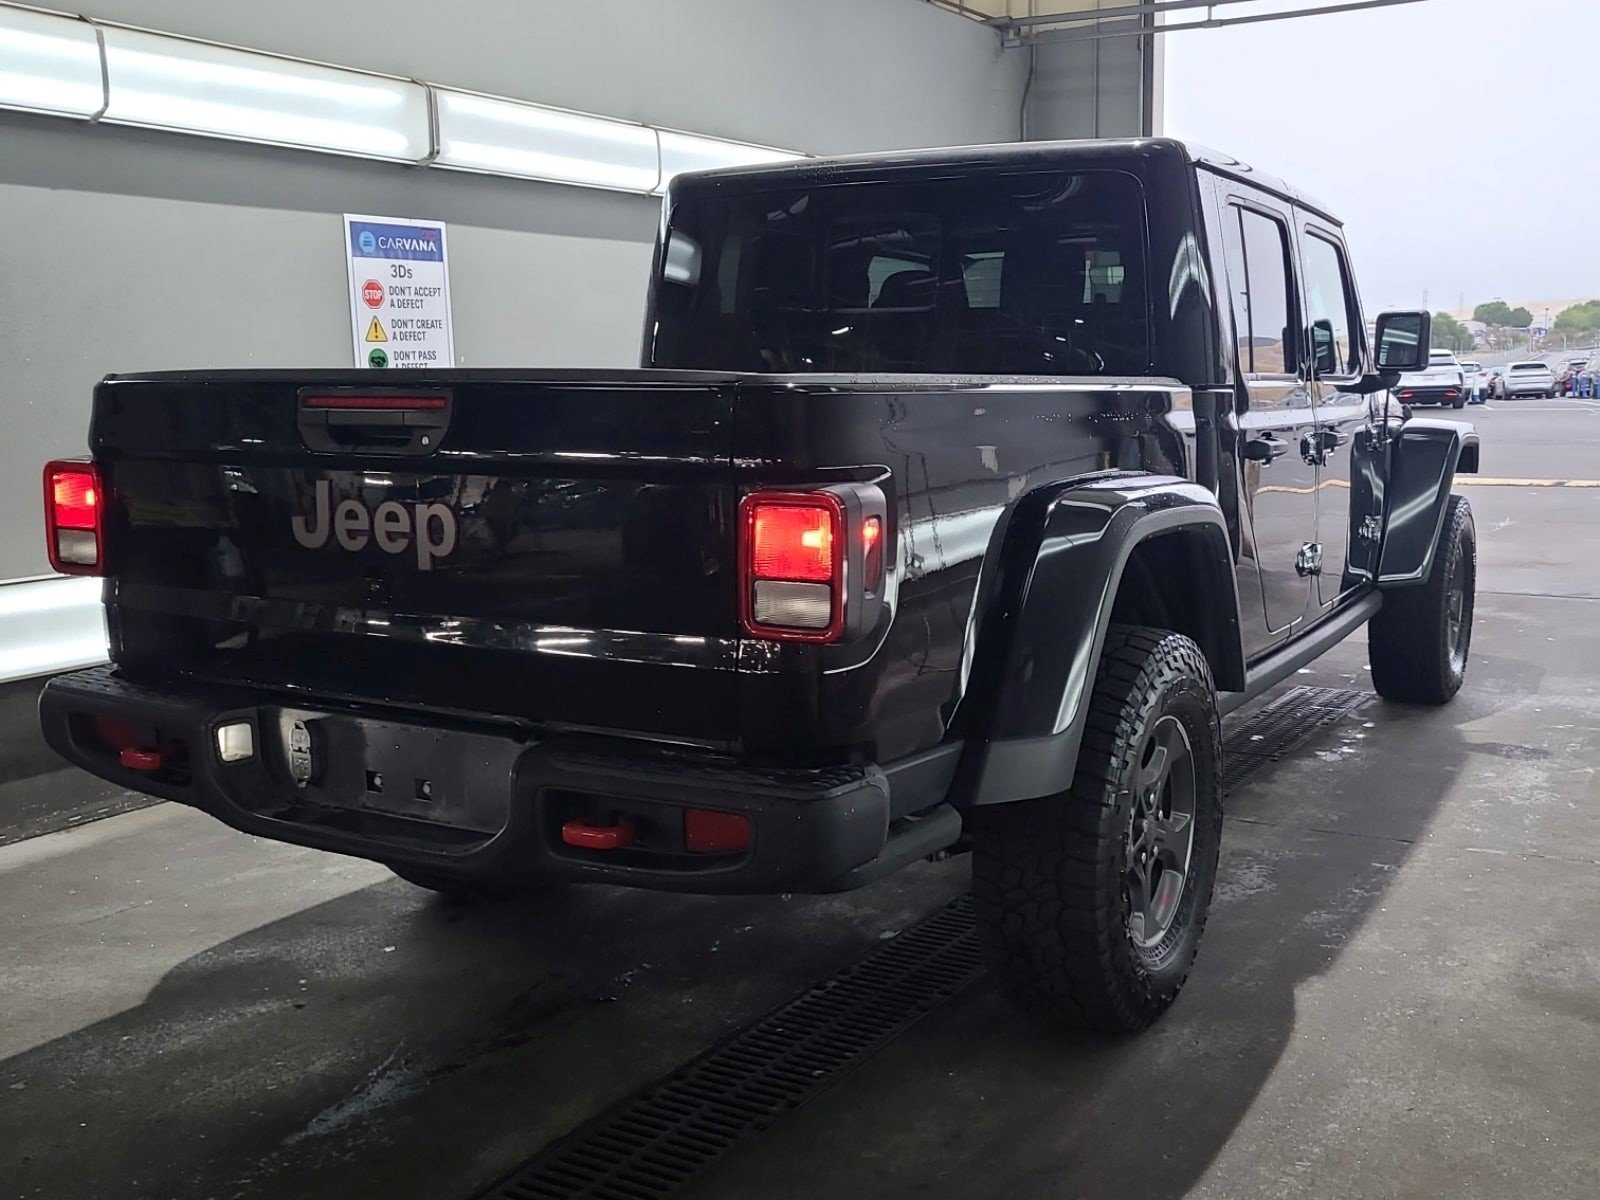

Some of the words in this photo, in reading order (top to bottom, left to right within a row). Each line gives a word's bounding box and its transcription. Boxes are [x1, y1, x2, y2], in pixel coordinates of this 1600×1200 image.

[378, 236, 437, 252] CARVANA
[390, 264, 413, 279] 3Ds
[364, 289, 382, 301] STOP
[389, 285, 412, 296] DON'T
[414, 286, 441, 297] ACCEPT
[390, 298, 396, 309] A
[397, 298, 424, 309] DEFECT
[391, 318, 414, 329] DON'T
[416, 319, 443, 330] CREATE
[392, 331, 398, 341] A
[399, 331, 426, 341] DEFECT
[393, 350, 416, 361] DON'T
[418, 350, 437, 361] PASS
[291, 480, 456, 571] Jeep
